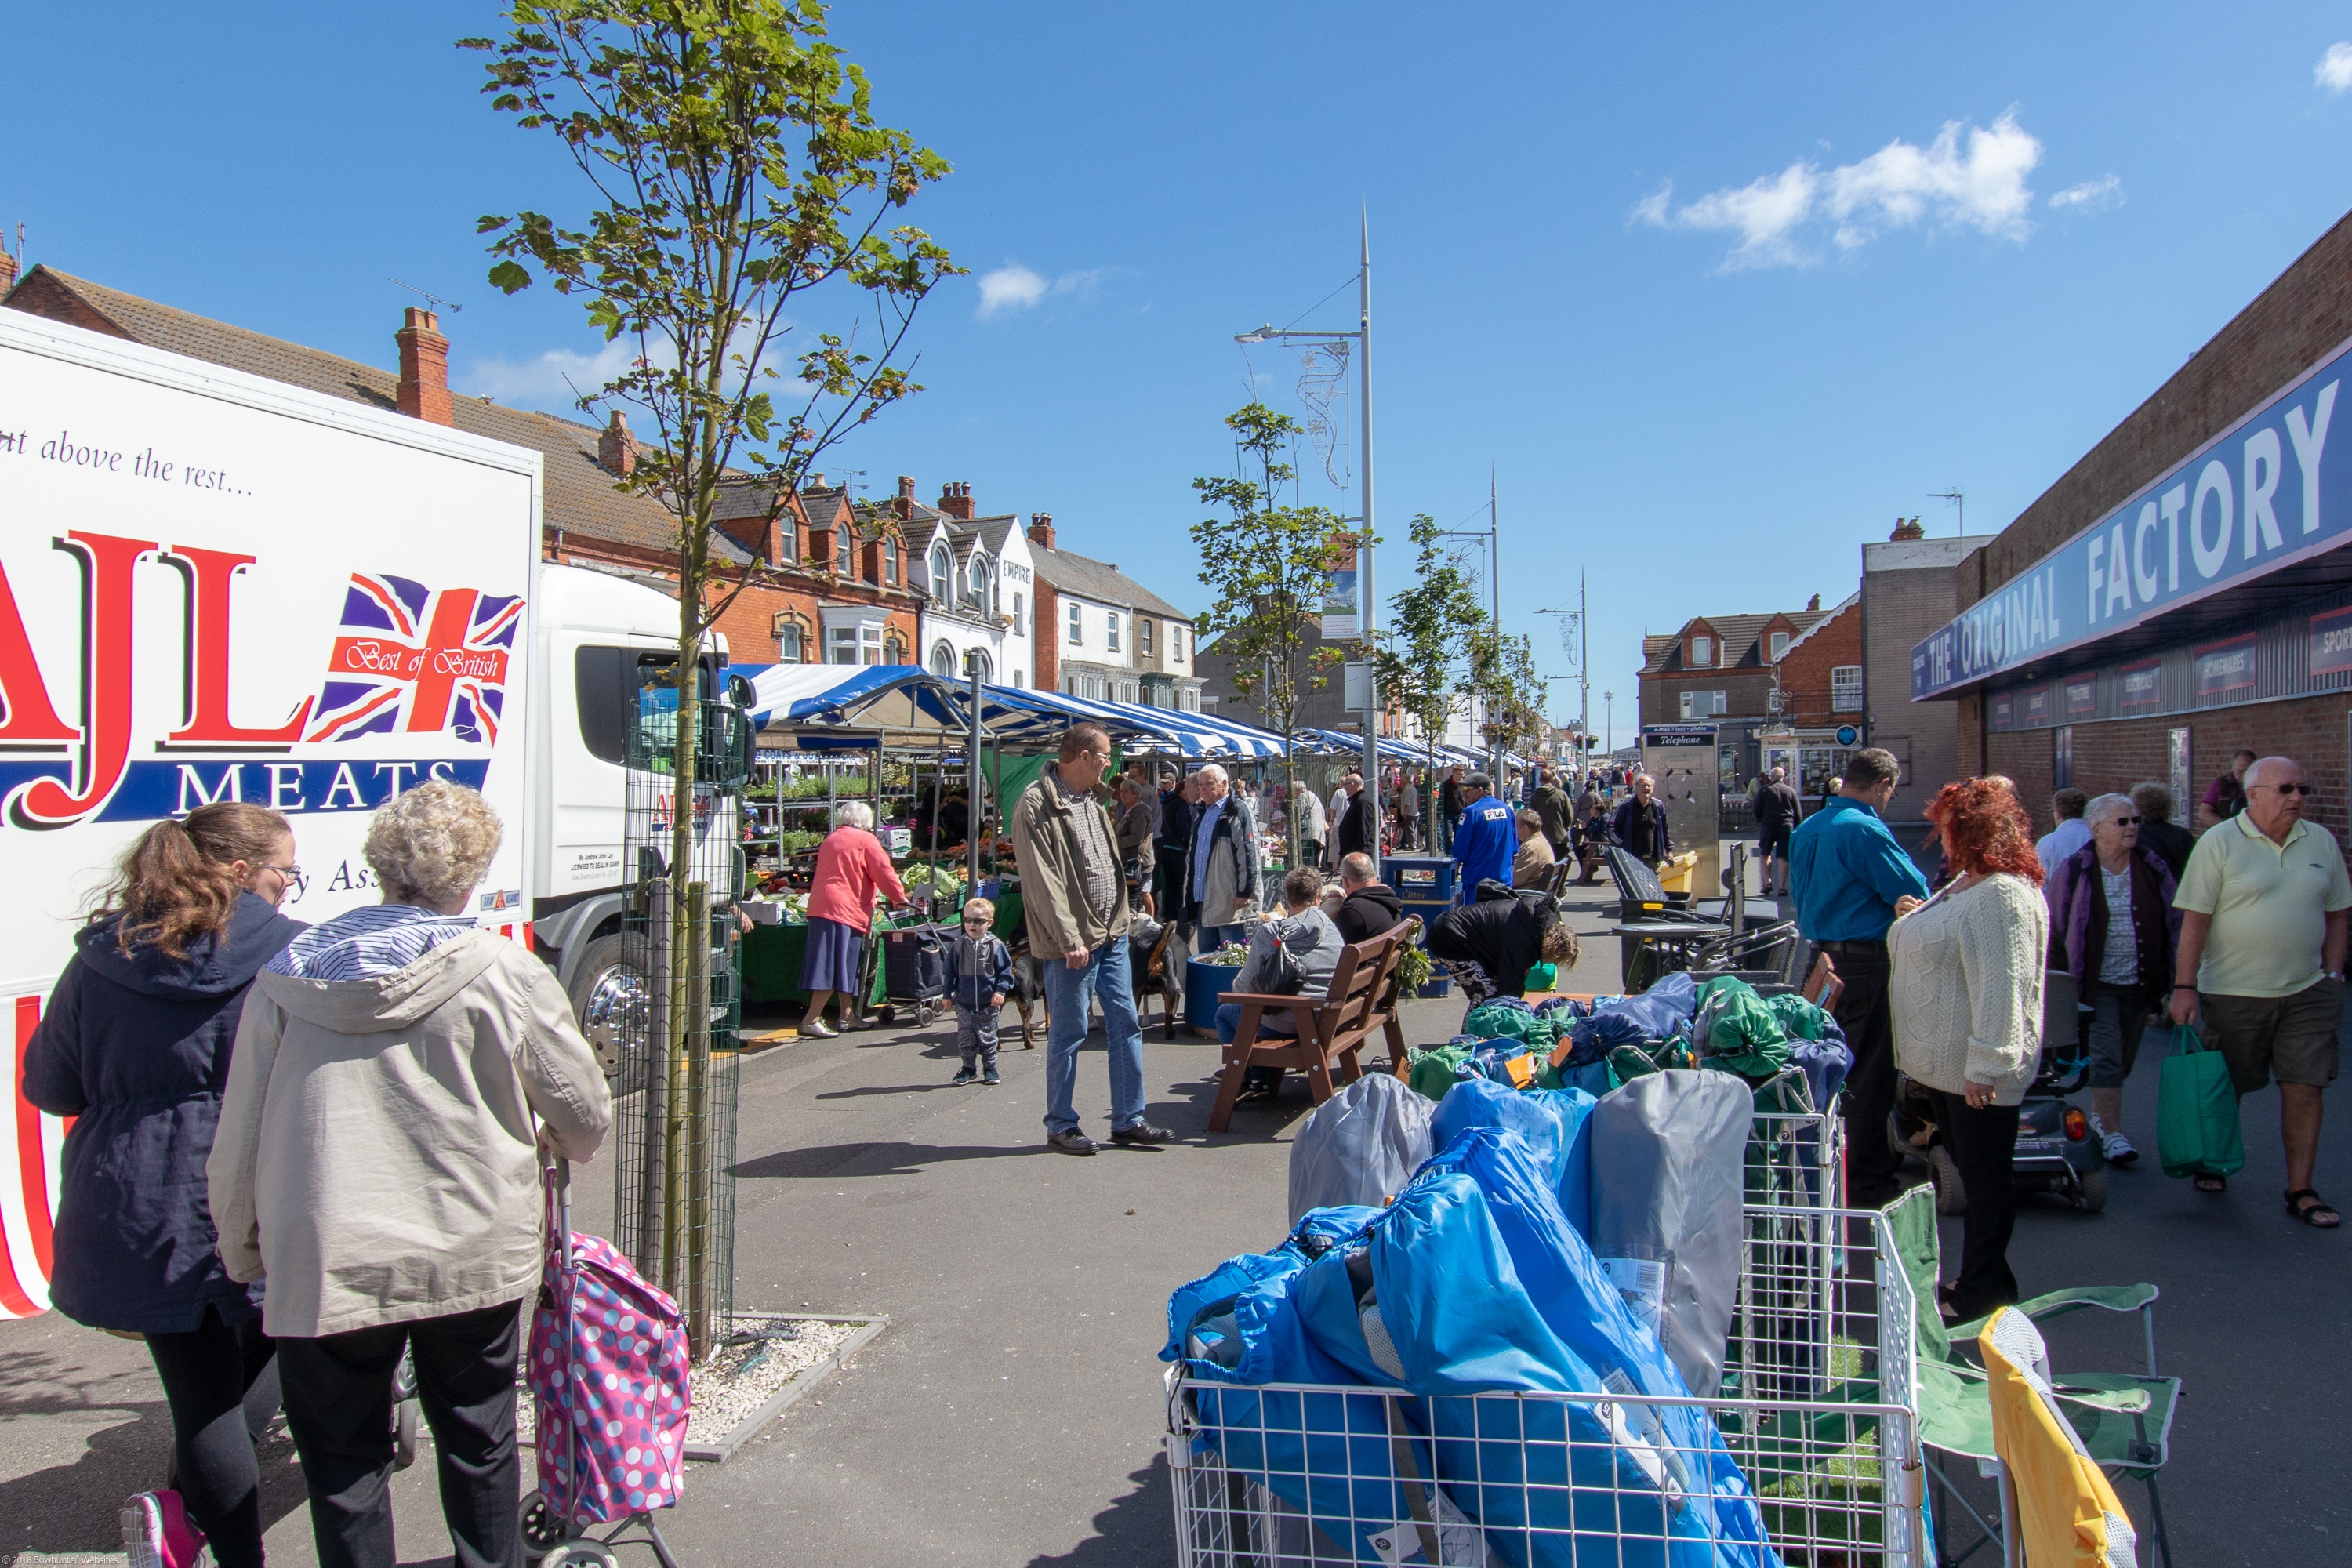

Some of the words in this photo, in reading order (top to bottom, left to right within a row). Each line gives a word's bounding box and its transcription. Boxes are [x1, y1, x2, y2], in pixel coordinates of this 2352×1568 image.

[41, 430, 122, 471] above
[134, 448, 174, 481] the
[184, 466, 252, 496] rest...
[1929, 632, 1951, 687] THE
[1961, 566, 2060, 675] ORIGINAL
[2088, 378, 2339, 625] FACTORY
[1004, 559, 1031, 584] EMPIRE
[345, 640, 402, 670] Best
[408, 647, 431, 681] of
[434, 647, 499, 677] British
[2204, 653, 2245, 679] HOMEWARES
[1661, 735, 1700, 746] Telephone
[483, 895, 495, 907] GRAY
[506, 892, 520, 904] ADAMS
